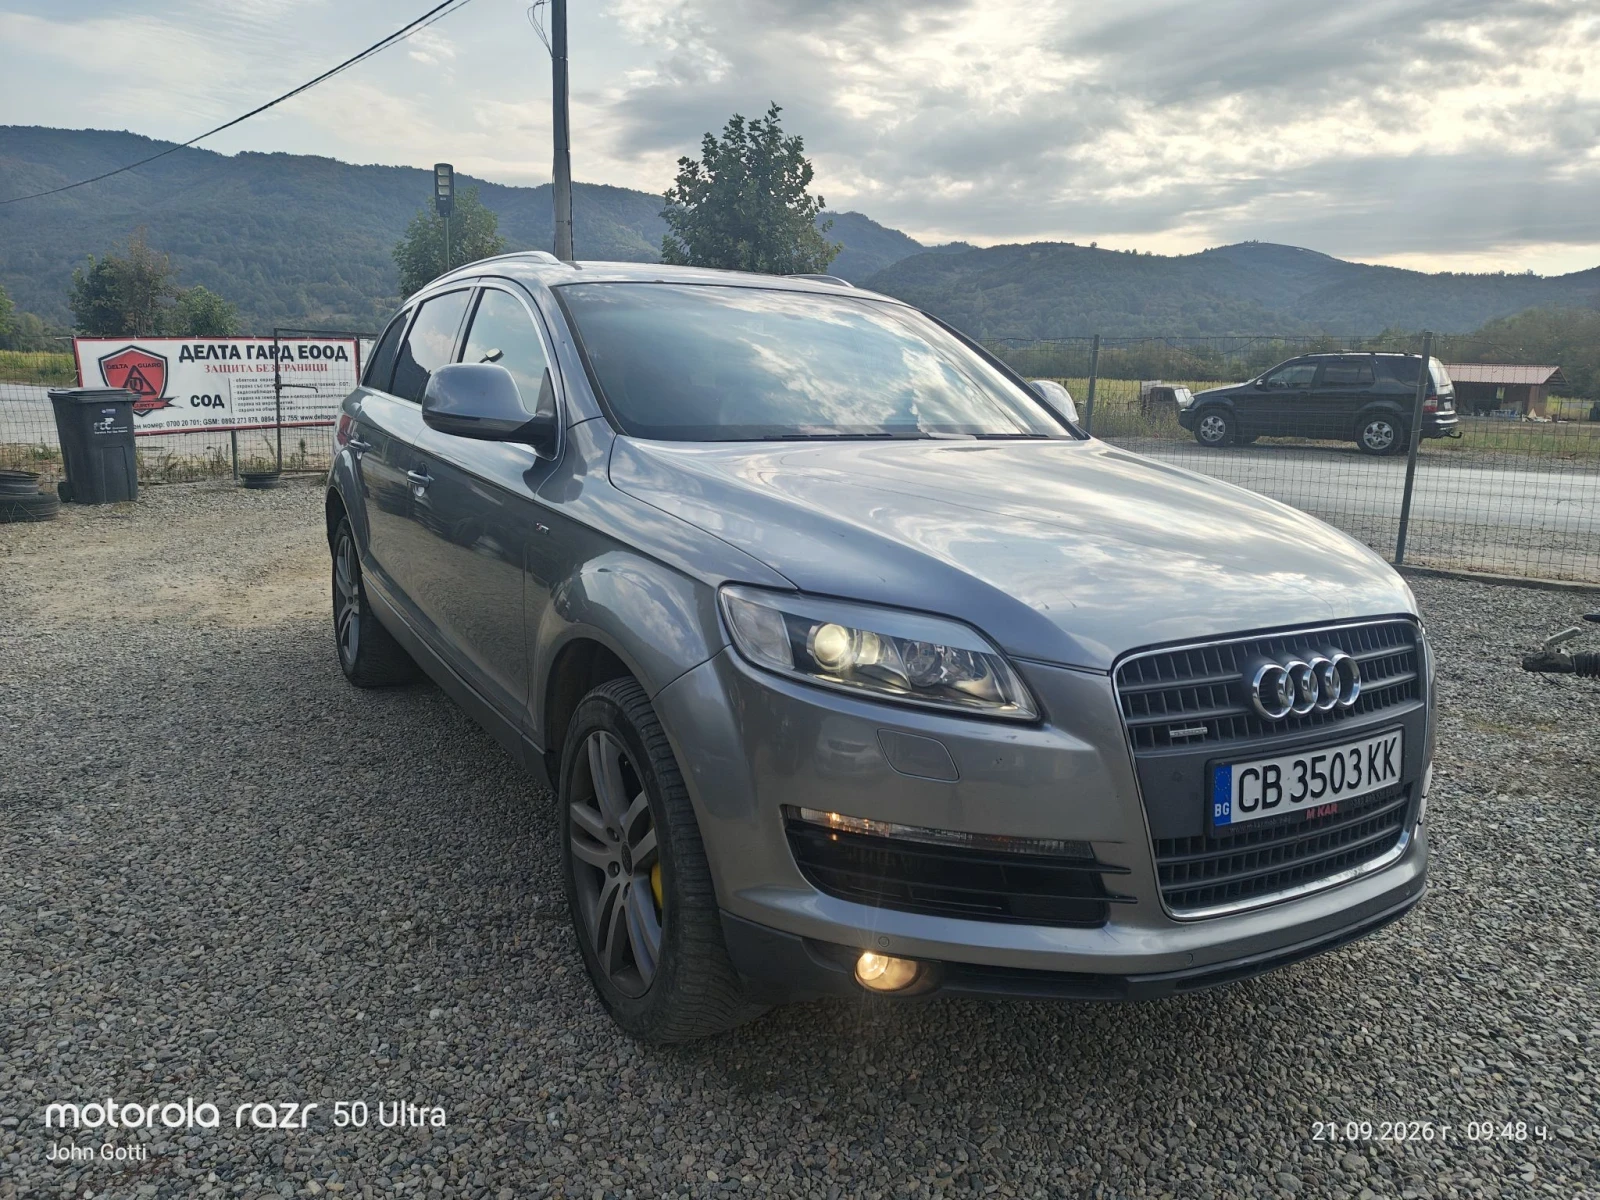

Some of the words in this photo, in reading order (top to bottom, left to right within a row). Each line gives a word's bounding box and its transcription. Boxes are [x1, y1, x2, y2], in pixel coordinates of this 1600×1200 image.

[179, 345, 242, 363] ДЕЛТА
[246, 345, 294, 362] ГАРД
[298, 345, 348, 362] ЕООД
[204, 364, 253, 374] ЗАЩИТА
[256, 364, 275, 373] БЕЗ
[190, 394, 225, 409] СОД
[1238, 763, 1283, 813] CB
[1290, 747, 1362, 803] 3503
[1367, 736, 1397, 786] KK
[1214, 802, 1230, 817] BG
[1306, 808, 1316, 820] M
[1317, 804, 1338, 817] KAR
